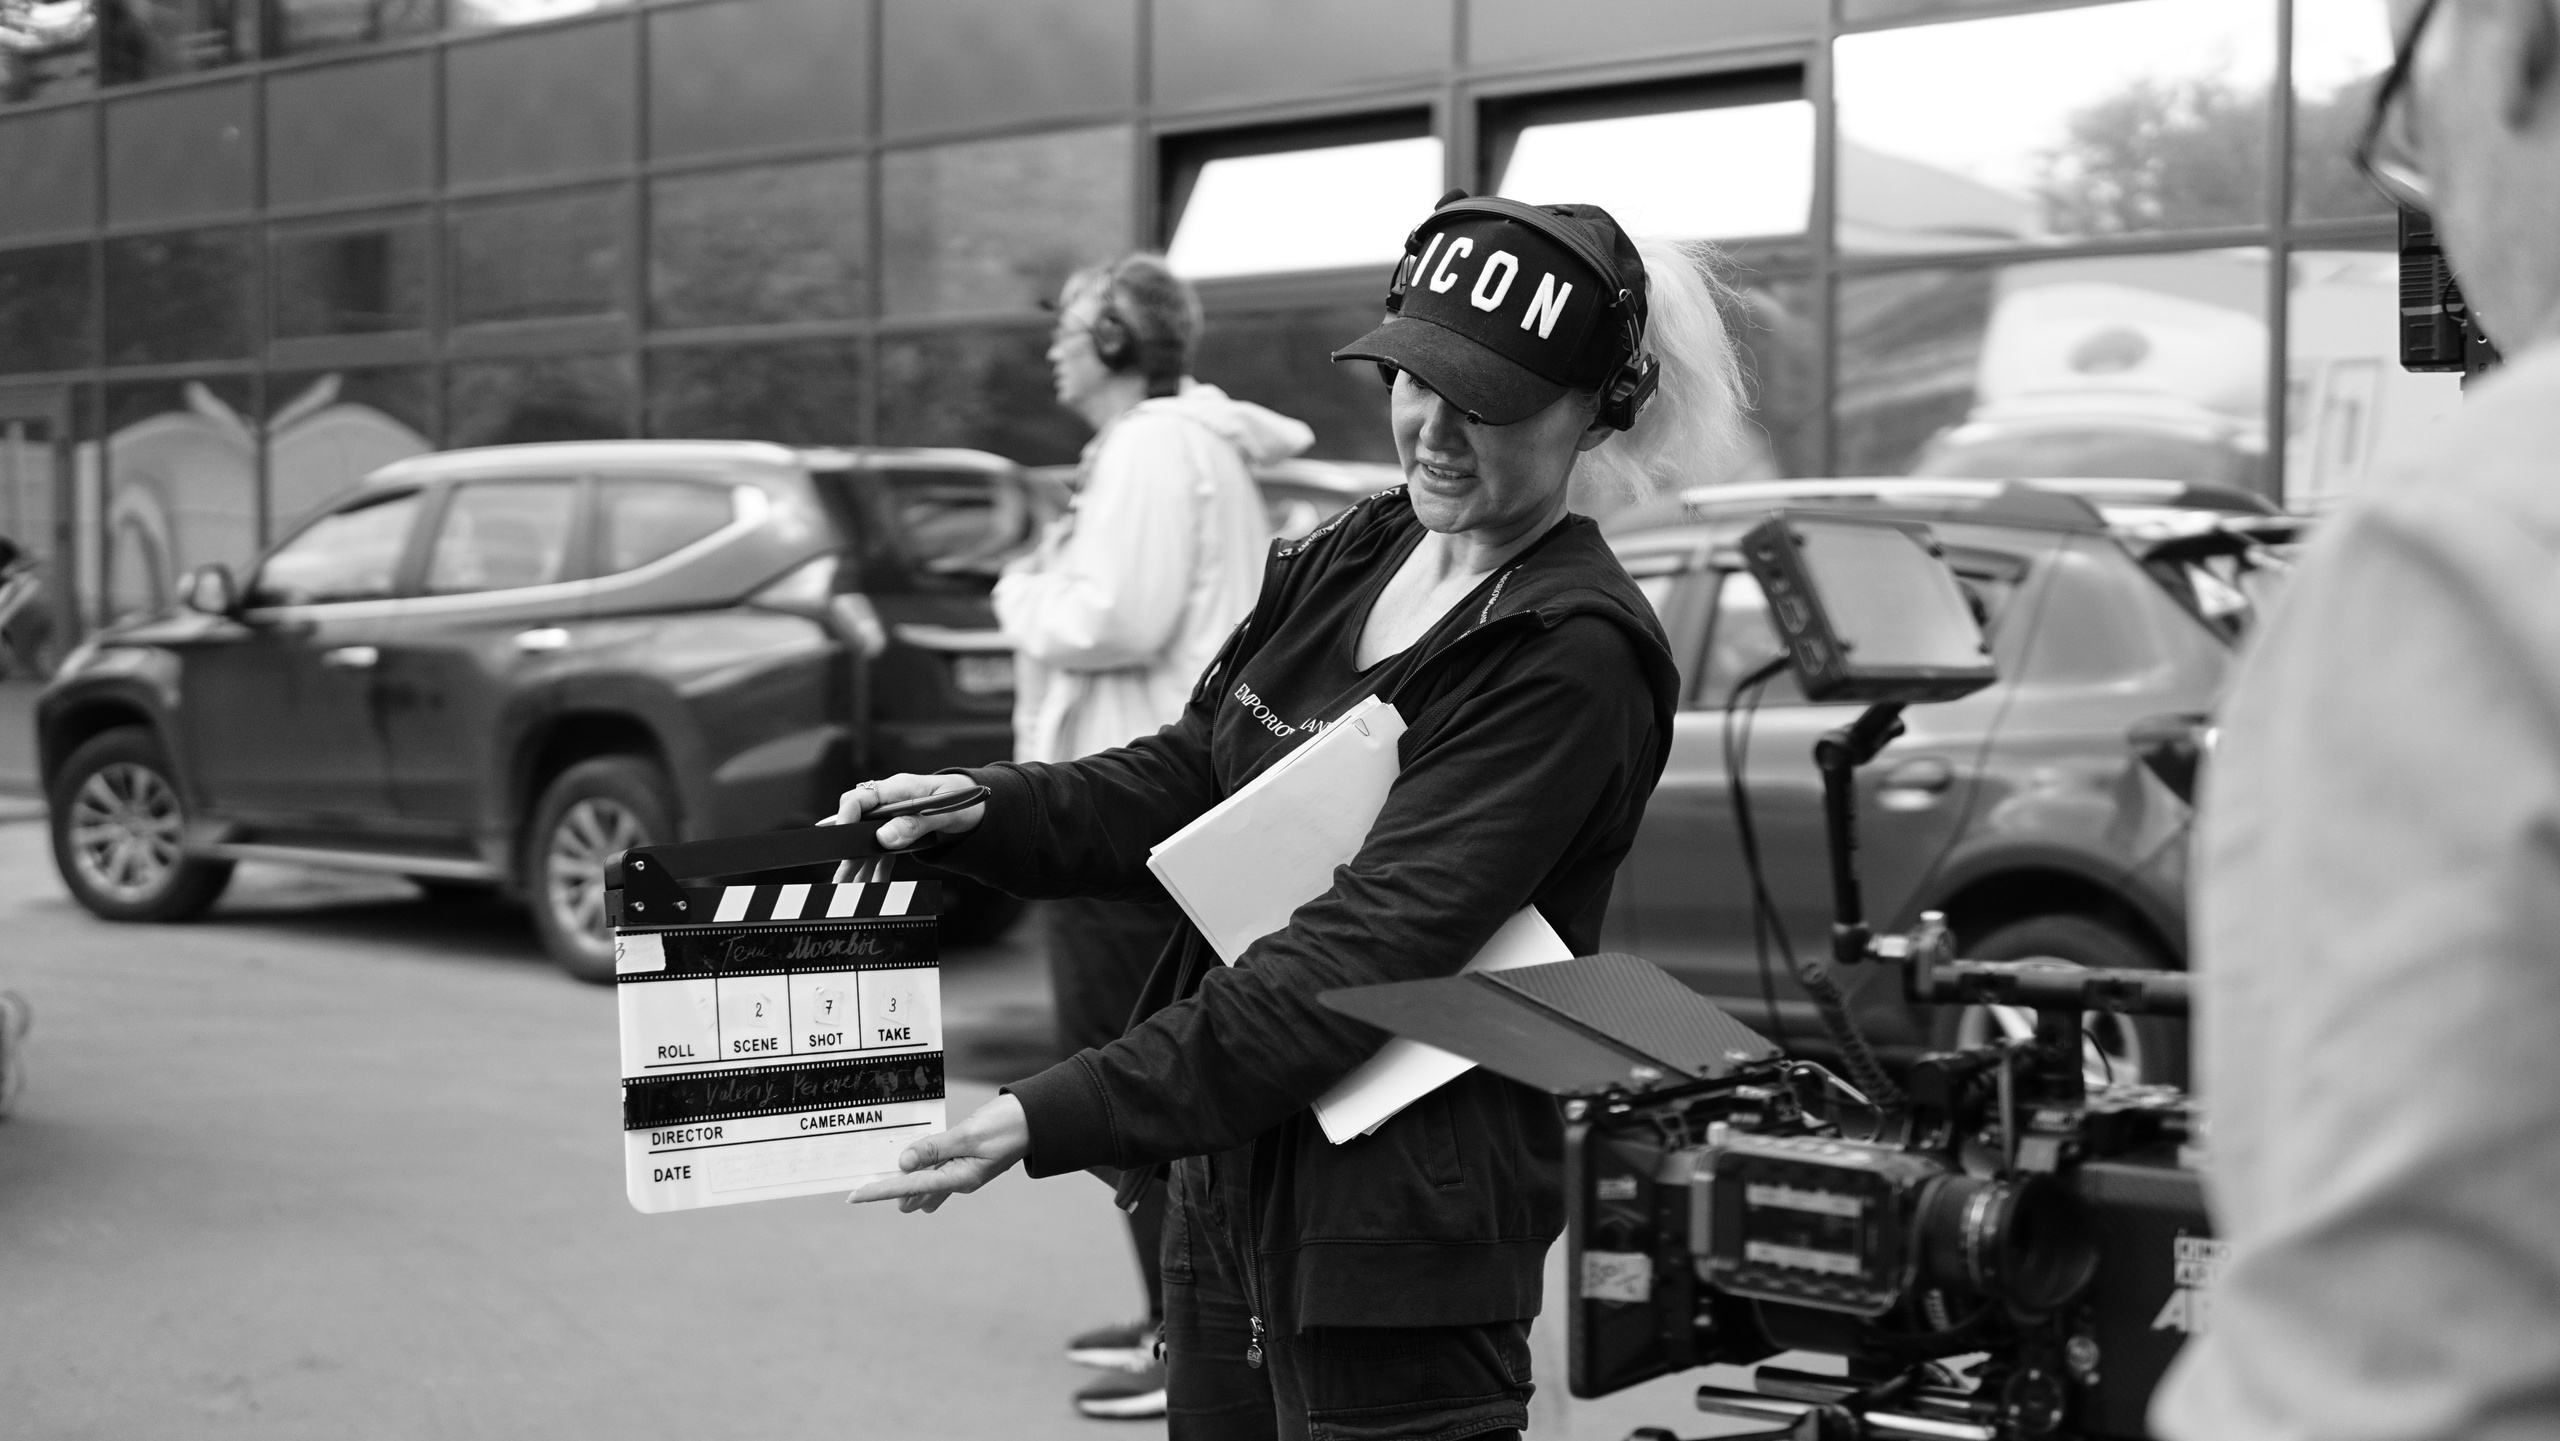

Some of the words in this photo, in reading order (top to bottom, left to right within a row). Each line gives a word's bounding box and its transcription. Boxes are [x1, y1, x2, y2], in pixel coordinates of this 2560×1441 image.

[1410, 231, 1573, 340] ICON
[1234, 682, 1291, 737] EMPORIO
[755, 1002, 763, 1018] 2
[825, 999, 833, 1015] 7
[888, 997, 897, 1012] 3
[809, 1032, 843, 1047] SHOT
[878, 1027, 911, 1041] TAKE
[658, 1044, 695, 1059] ROLL
[733, 1037, 778, 1053] SCENE
[800, 1110, 883, 1130] CAMERAMAN
[652, 1126, 723, 1146] DIRECTOR
[654, 1165, 691, 1182] DATE
